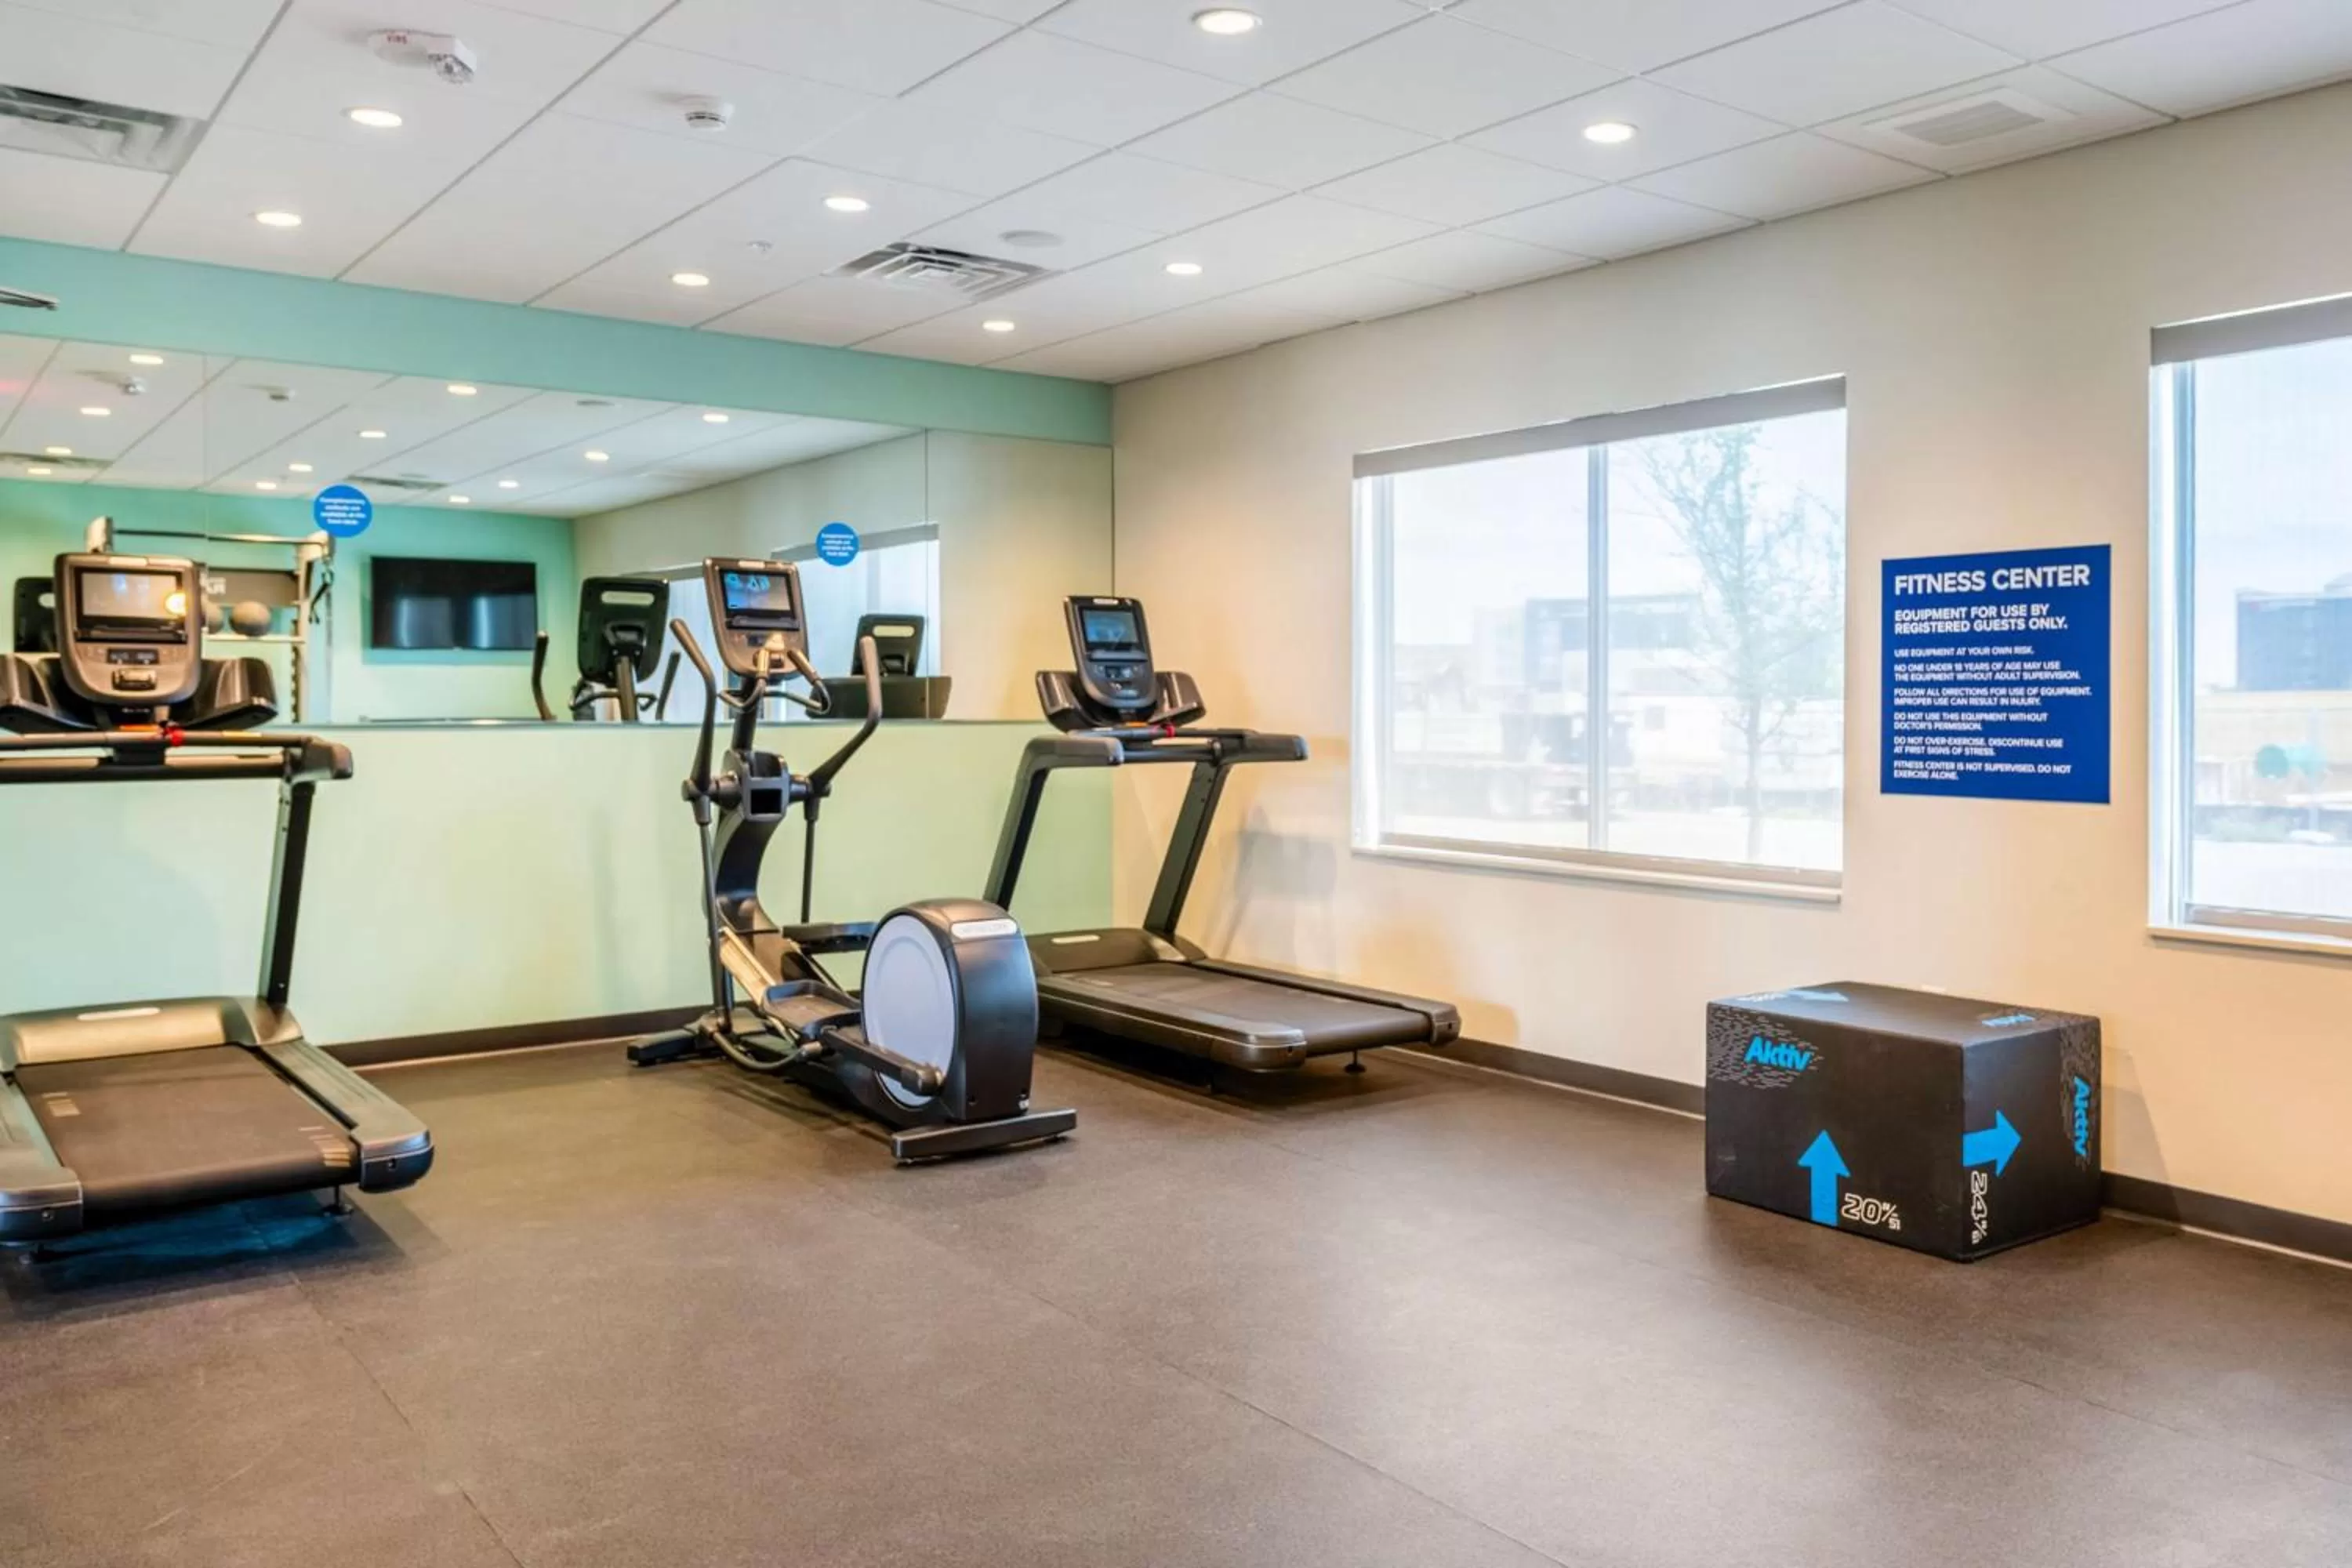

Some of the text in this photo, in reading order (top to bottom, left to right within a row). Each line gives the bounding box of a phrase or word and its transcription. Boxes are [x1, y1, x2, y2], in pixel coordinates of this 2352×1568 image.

[1895, 564, 2090, 596] FITNESS CENTER
[1894, 603, 2050, 622] EQUIPMENT FOR USE BY
[1894, 615, 2068, 635] REGISTERED GUESTS ONLY.
[1893, 648, 1909, 658] USE
[1956, 647, 1967, 656] AT
[1968, 646, 1990, 656] YOUR
[1991, 645, 2013, 655] OWN
[1907, 663, 1925, 672] ONE
[1925, 662, 1953, 672] UNDER
[1964, 662, 1991, 672] YEARS
[1991, 662, 2004, 670] OF
[2042, 660, 2061, 670] USE
[1894, 672, 1909, 682] THE
[1956, 672, 1993, 681] WITHOUT
[1994, 671, 2021, 681] ADULT
[1893, 688, 1926, 697] FOLLOW
[1926, 687, 1940, 696] ALL
[1990, 687, 2008, 696] FOR
[2008, 687, 2027, 696] USE
[2027, 687, 2039, 696] OF
[1933, 697, 1950, 706] USE
[1950, 697, 1969, 706] CAN
[1893, 712, 1907, 720] DO
[1907, 712, 1924, 720] NOT
[2008, 712, 2049, 722] WITHOUT
[1893, 736, 1907, 745] DO
[1907, 736, 1924, 745] NOT
[2045, 738, 2064, 749] USE
[1951, 746, 1964, 756] OF
[1965, 762, 1983, 772] NOT
[2037, 764, 2053, 773] DO
[2053, 764, 2072, 774] NOT
[1744, 1035, 1812, 1071] Aktiv
[2073, 1076, 2090, 1158] Aktiv
